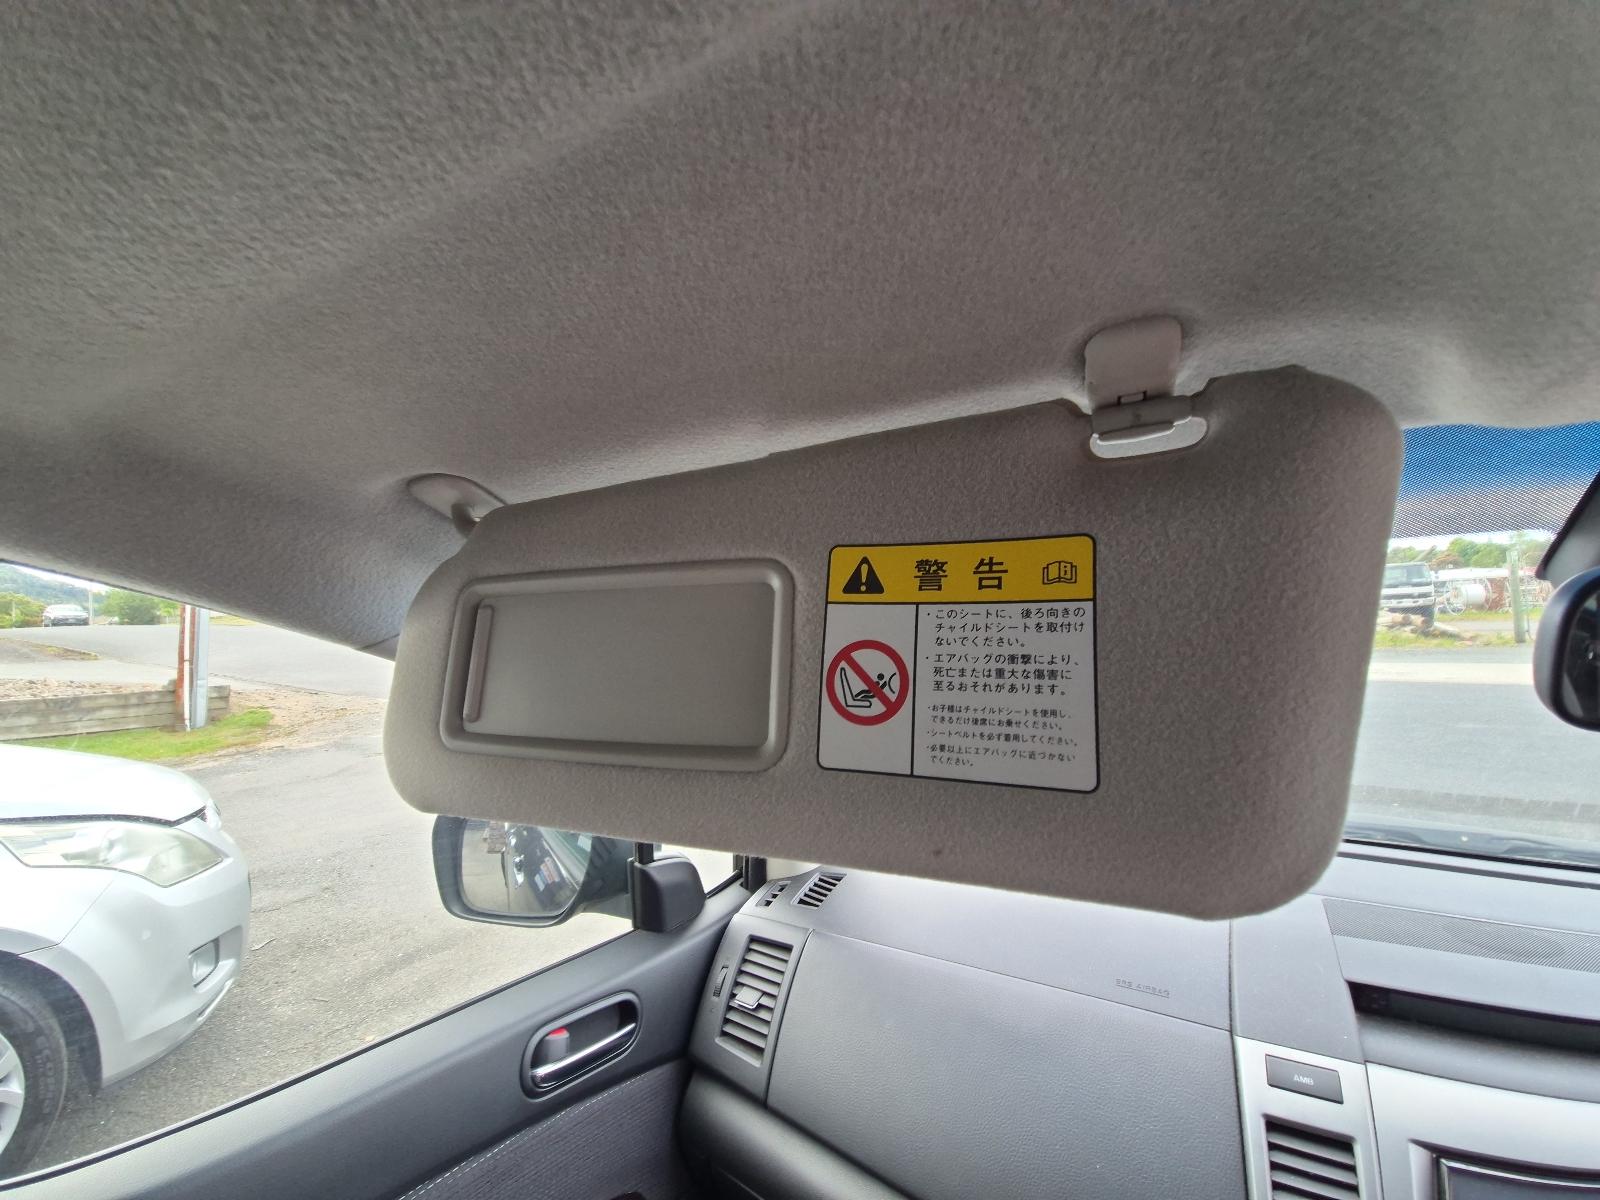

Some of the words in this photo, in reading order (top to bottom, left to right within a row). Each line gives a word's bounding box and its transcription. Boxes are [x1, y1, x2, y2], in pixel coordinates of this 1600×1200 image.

[914, 556, 1009, 592] 警告
[935, 621, 1085, 634] チャイルドシートを取付け
[933, 667, 1073, 680] 死亡または重大な傷害に
[1292, 1073, 1314, 1086] AMB
